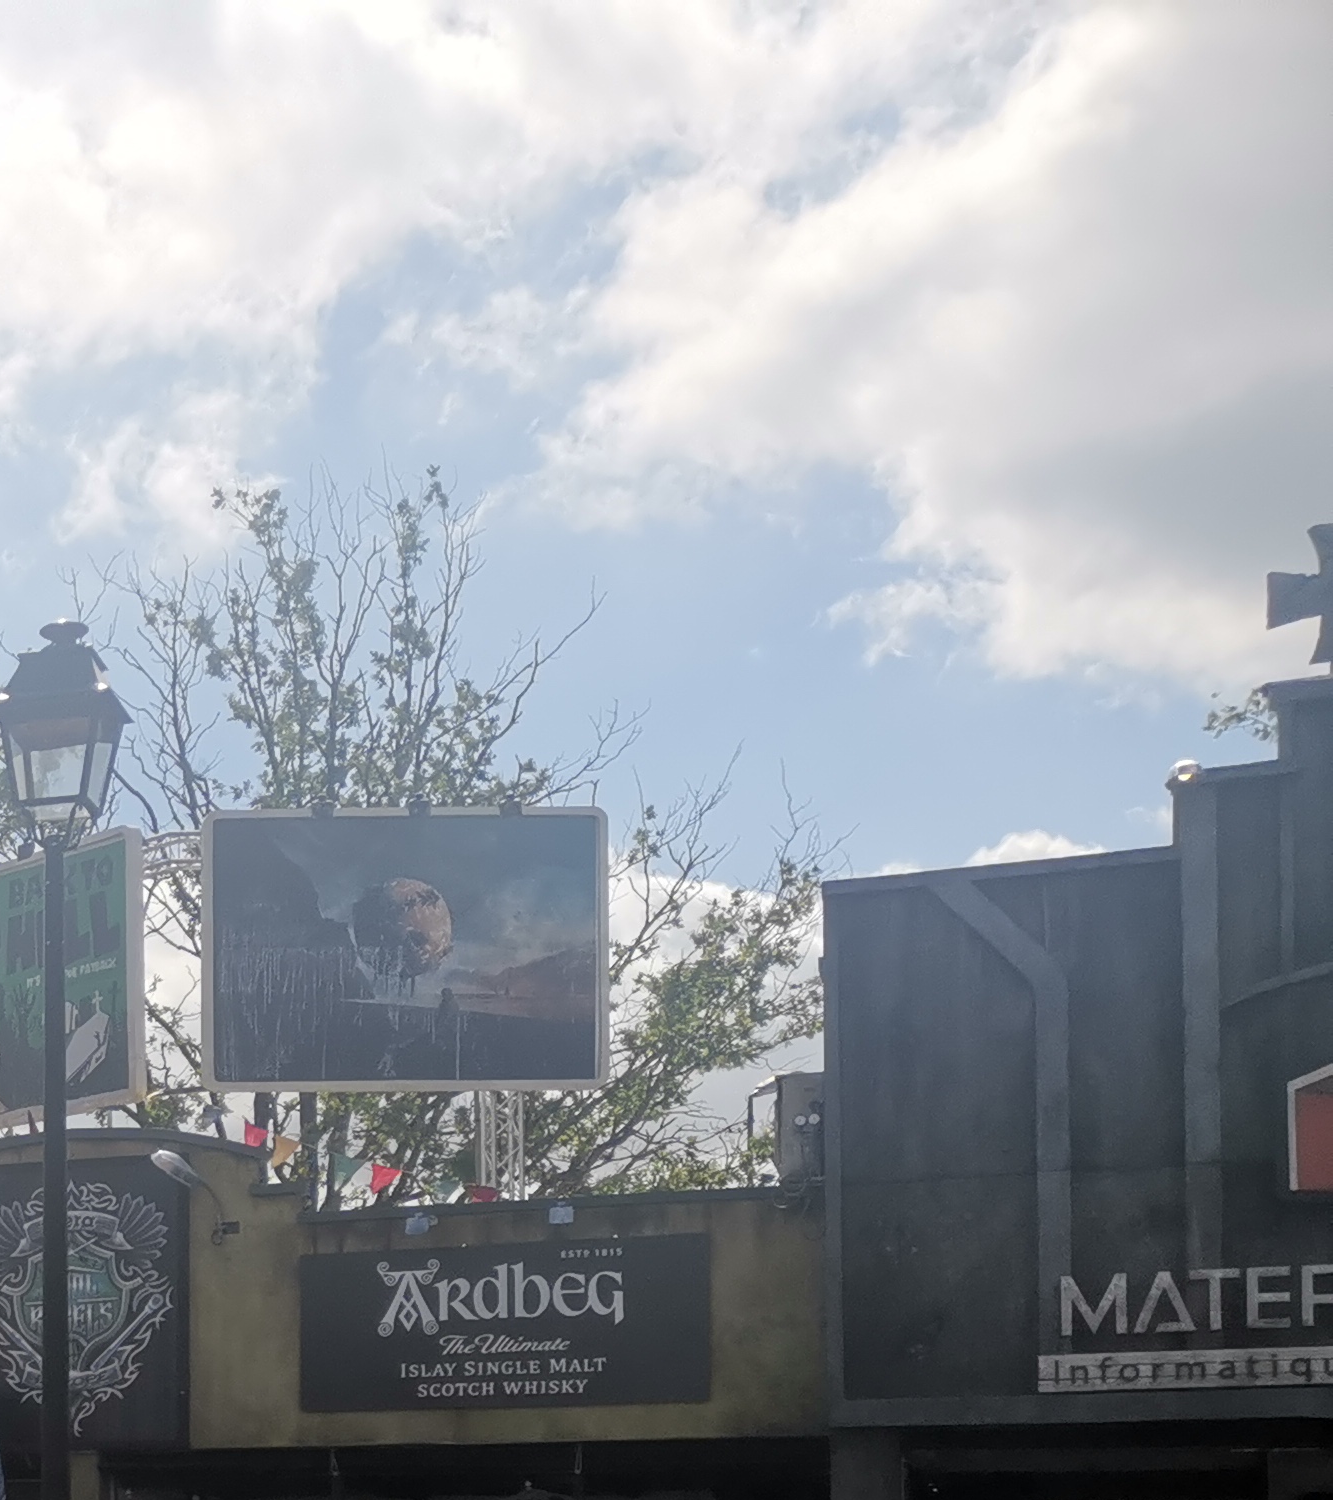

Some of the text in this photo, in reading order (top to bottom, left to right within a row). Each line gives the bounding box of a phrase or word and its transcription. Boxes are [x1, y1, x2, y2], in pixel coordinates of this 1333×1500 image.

[8, 862, 79, 910] BAK
[439, 1333, 571, 1356] The Ultimate
[400, 1356, 608, 1379] ISLAY SINGLE MALT
[416, 1378, 589, 1398] SCOTCH WHISKY
